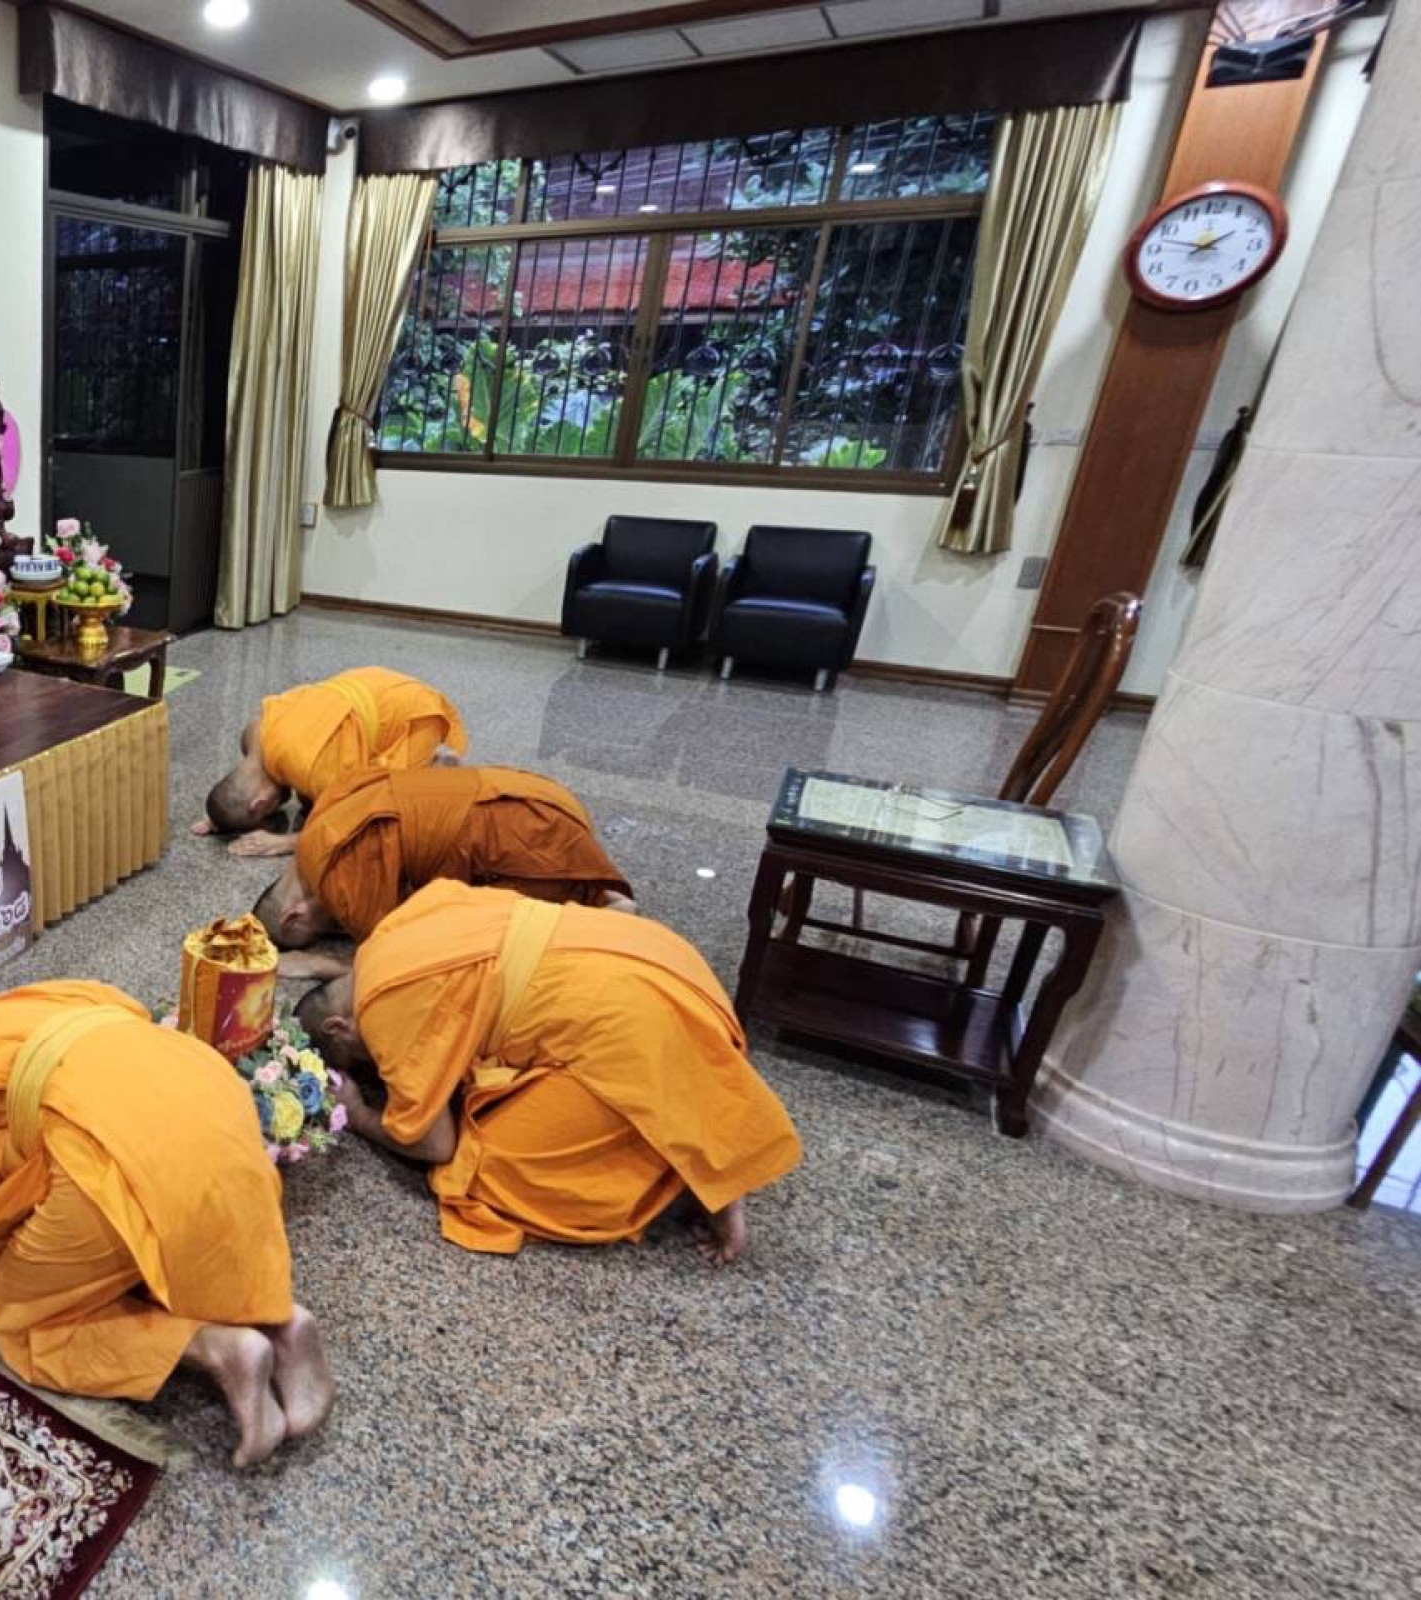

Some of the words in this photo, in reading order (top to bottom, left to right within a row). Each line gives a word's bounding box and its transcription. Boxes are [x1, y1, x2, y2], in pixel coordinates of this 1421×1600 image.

[1205, 199, 1228, 214] 12
[1234, 204, 1243, 217] 1
[1183, 207, 1200, 221] 11
[1160, 223, 1179, 237] 10
[1246, 217, 1261, 233] 2
[1147, 243, 1162, 255] 9
[1246, 239, 1263, 252] 3
[1148, 261, 1163, 275] 8
[1231, 258, 1246, 272] 4
[1165, 276, 1179, 289] 7
[1184, 279, 1200, 293] 6
[1207, 274, 1223, 287] 5
